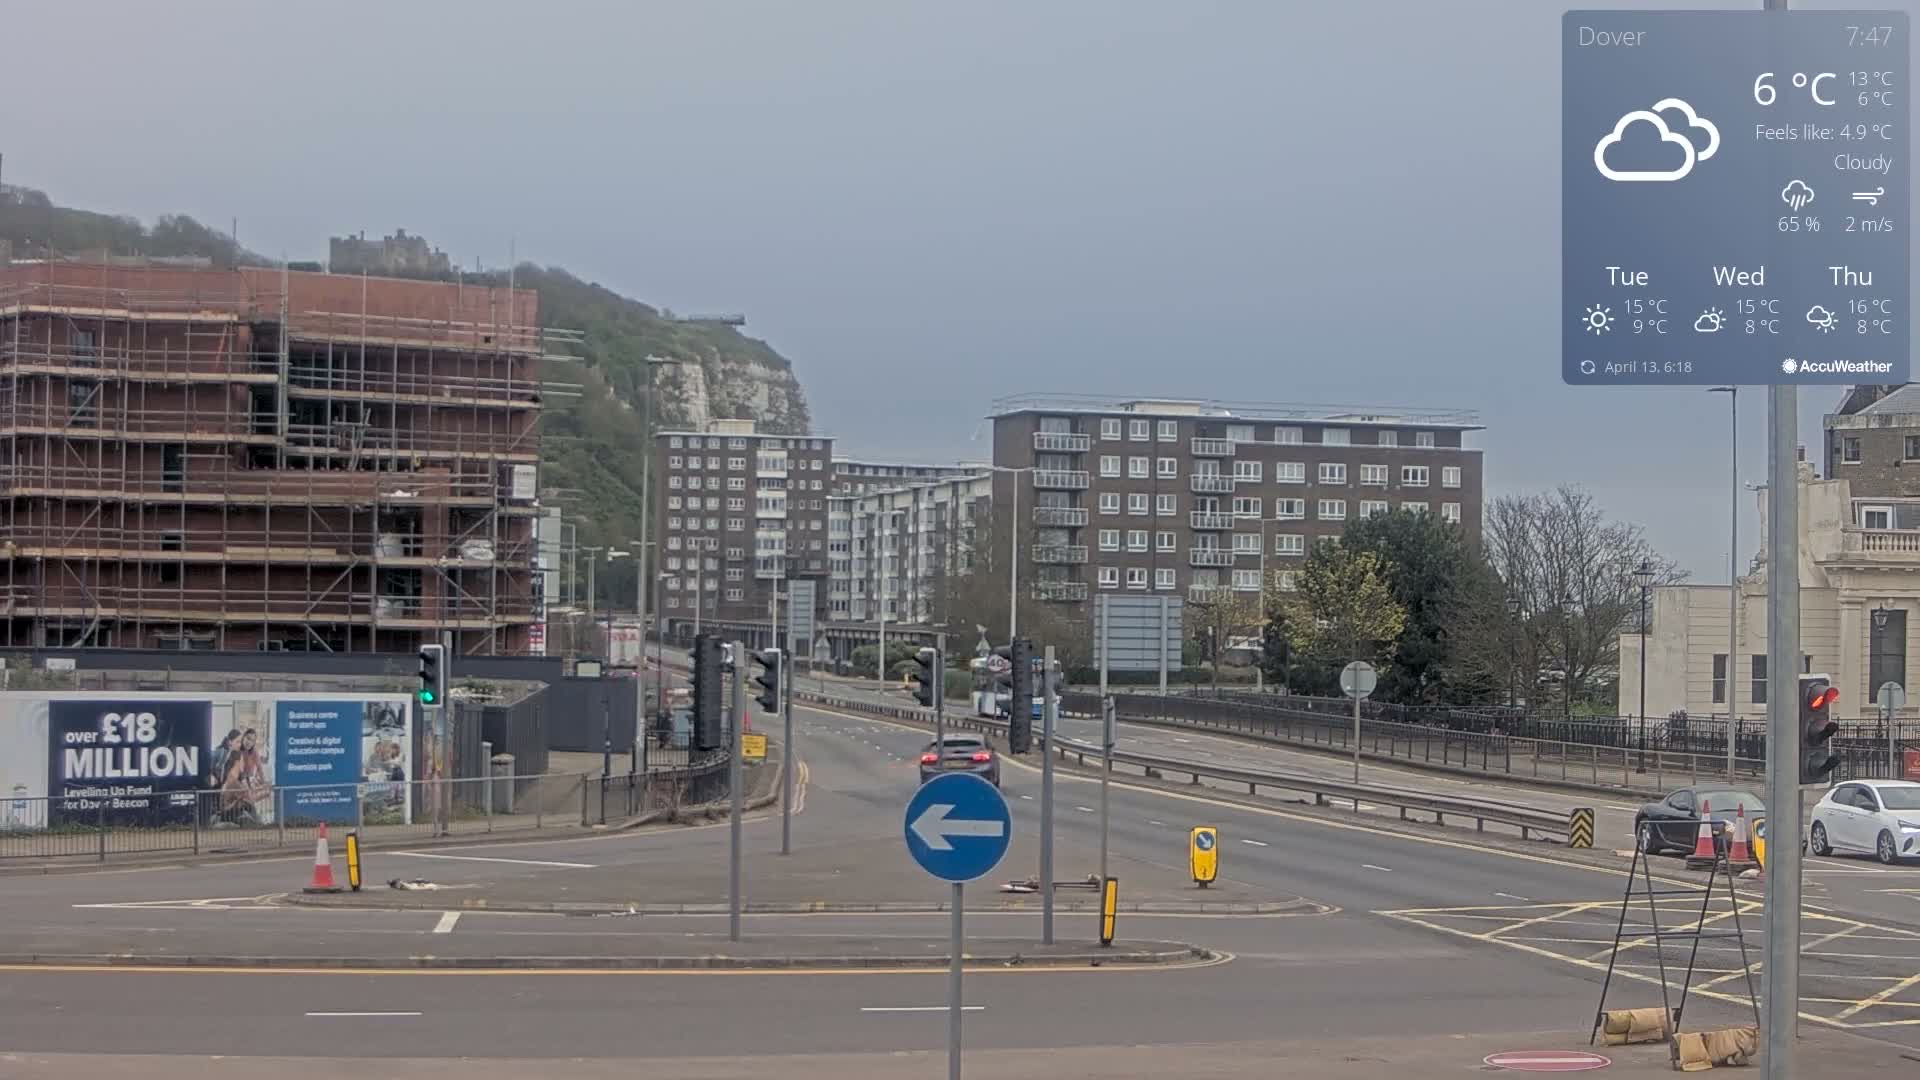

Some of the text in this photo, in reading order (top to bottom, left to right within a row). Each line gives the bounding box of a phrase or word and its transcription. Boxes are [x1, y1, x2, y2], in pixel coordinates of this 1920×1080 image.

[65, 712, 157, 743] over £18
[64, 746, 199, 779] MILLION
[64, 787, 109, 798] Levelling
[127, 785, 153, 796] Fund
[64, 800, 78, 810] for
[113, 798, 149, 809] Beacon
